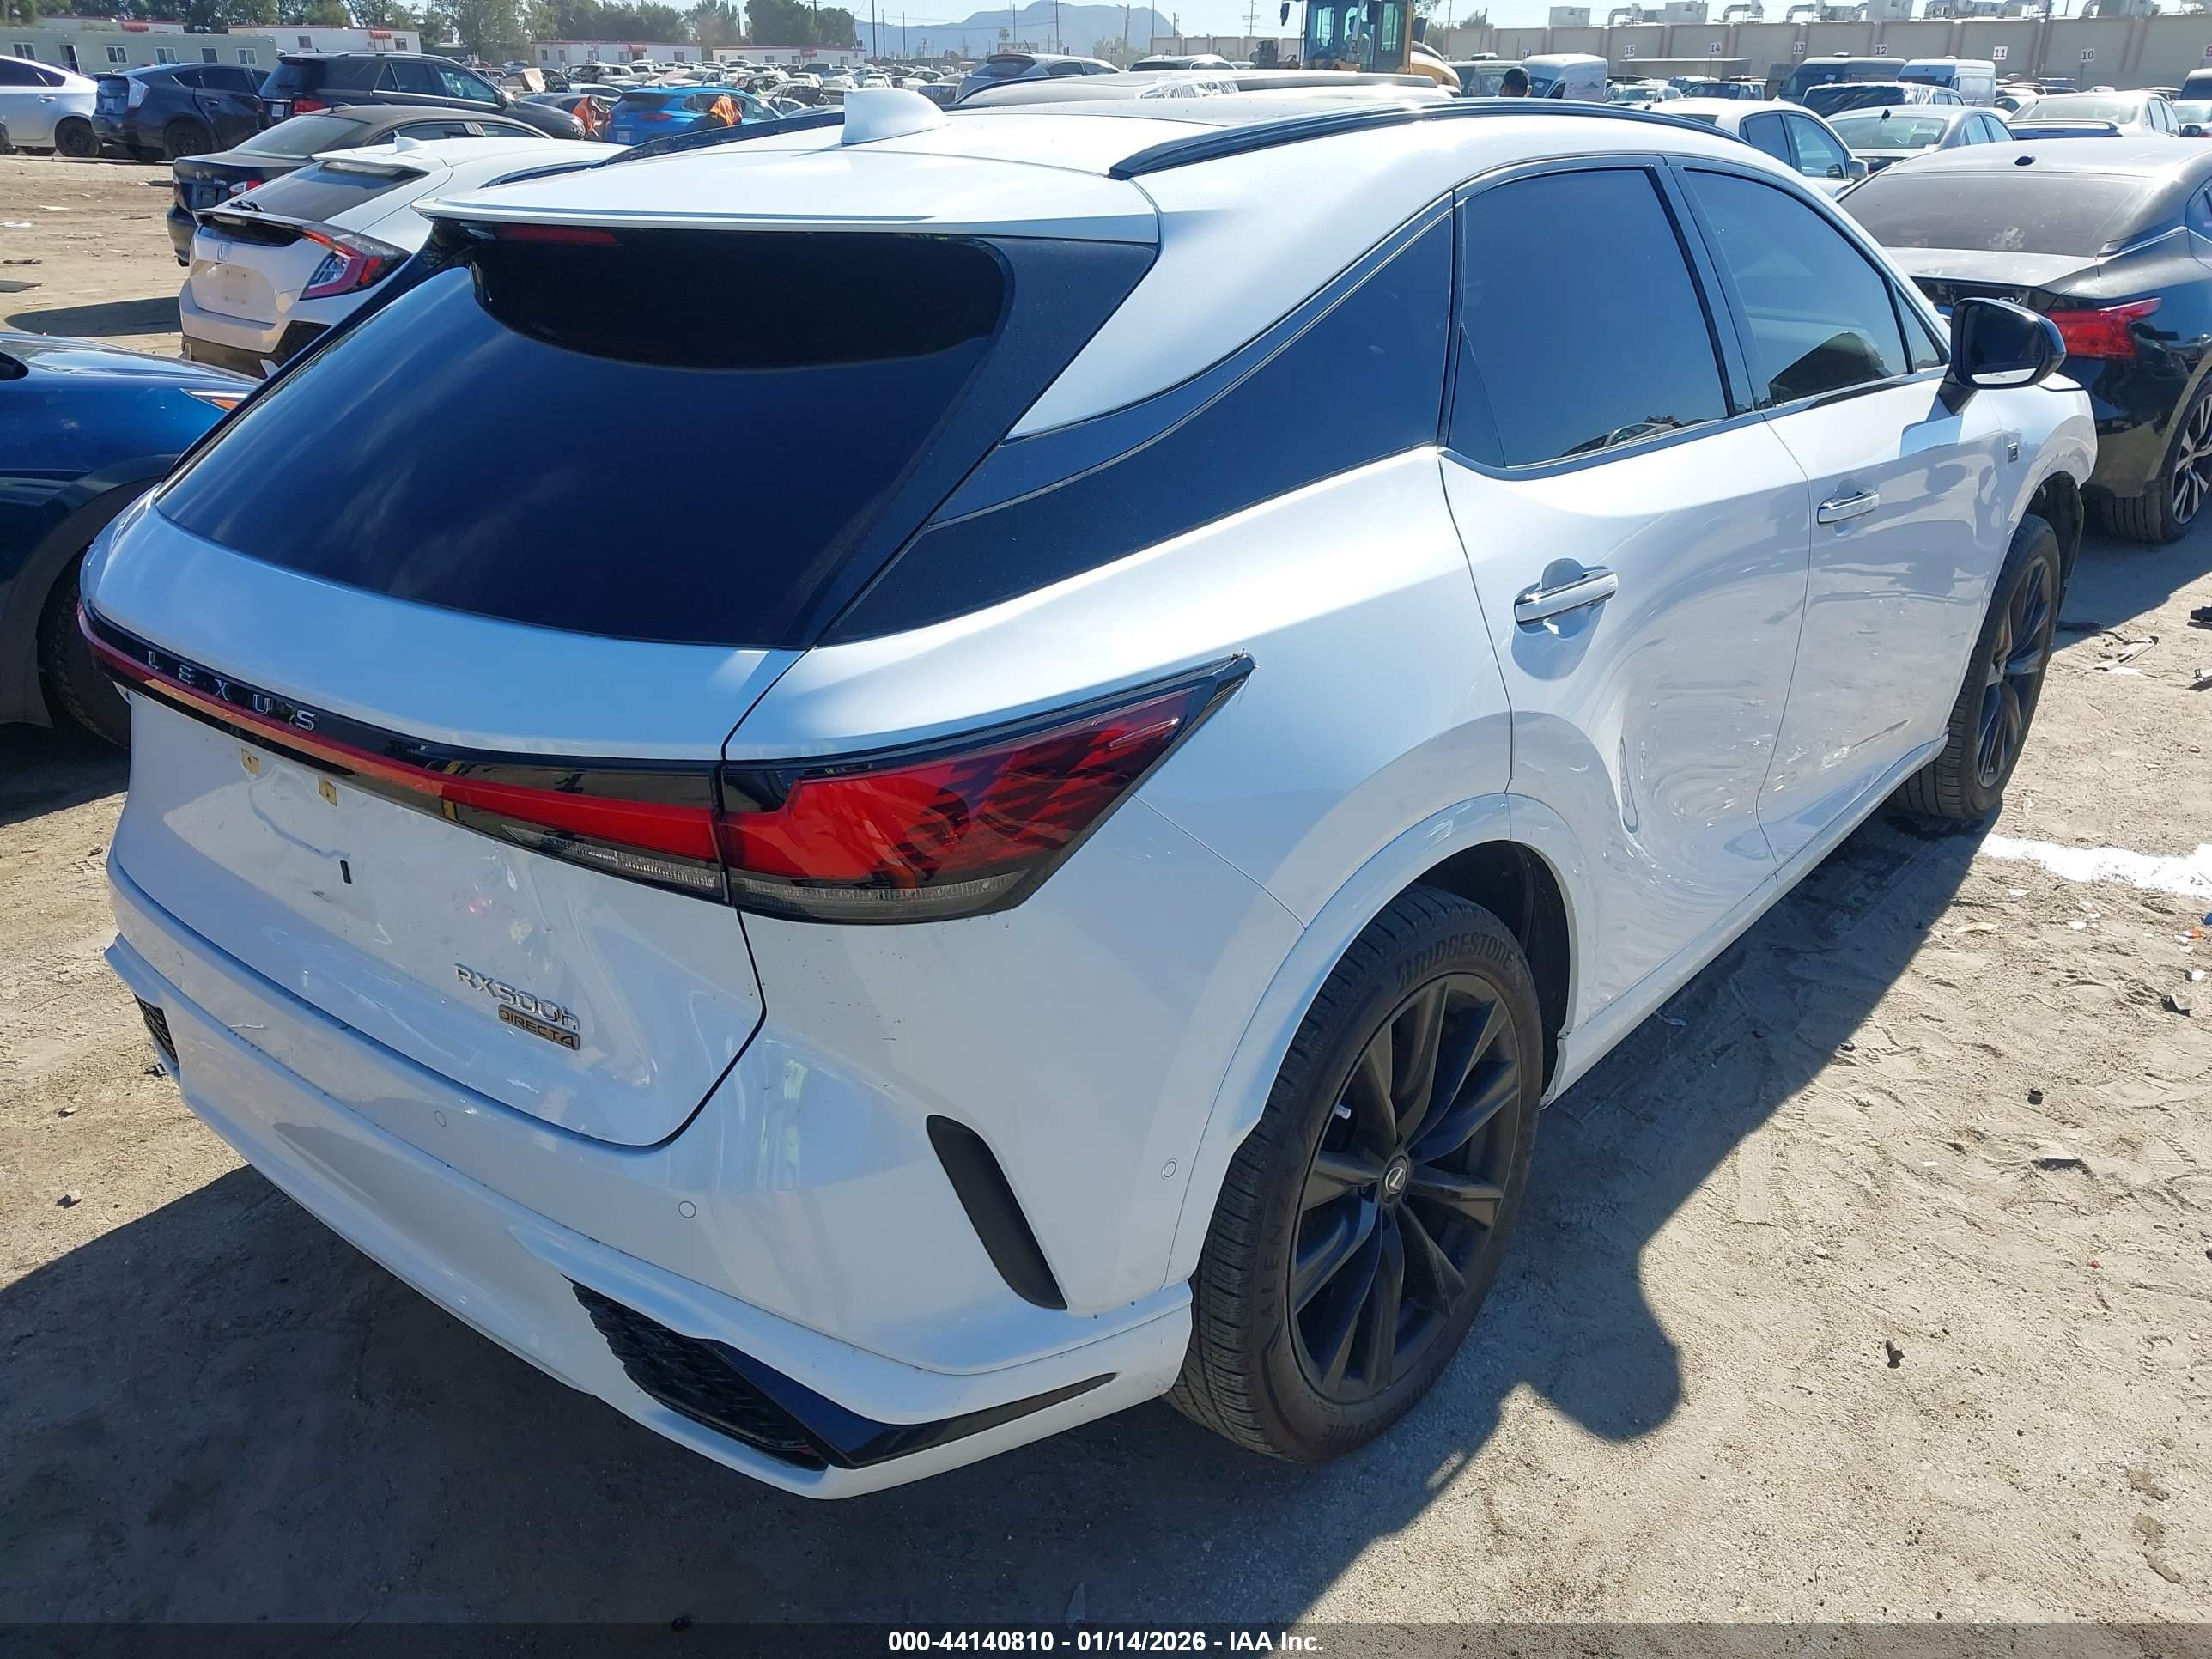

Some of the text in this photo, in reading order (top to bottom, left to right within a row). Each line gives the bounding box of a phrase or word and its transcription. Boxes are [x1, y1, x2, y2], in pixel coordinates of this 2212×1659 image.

[1875, 46, 1887, 55] 12
[1994, 48, 2007, 58] 11
[2081, 50, 2094, 60] 10
[147, 649, 317, 732] LEXUS
[1396, 931, 1515, 988] BRIDGESTONE
[453, 963, 580, 1030] RX500h
[498, 1006, 576, 1049] DIRECT4
